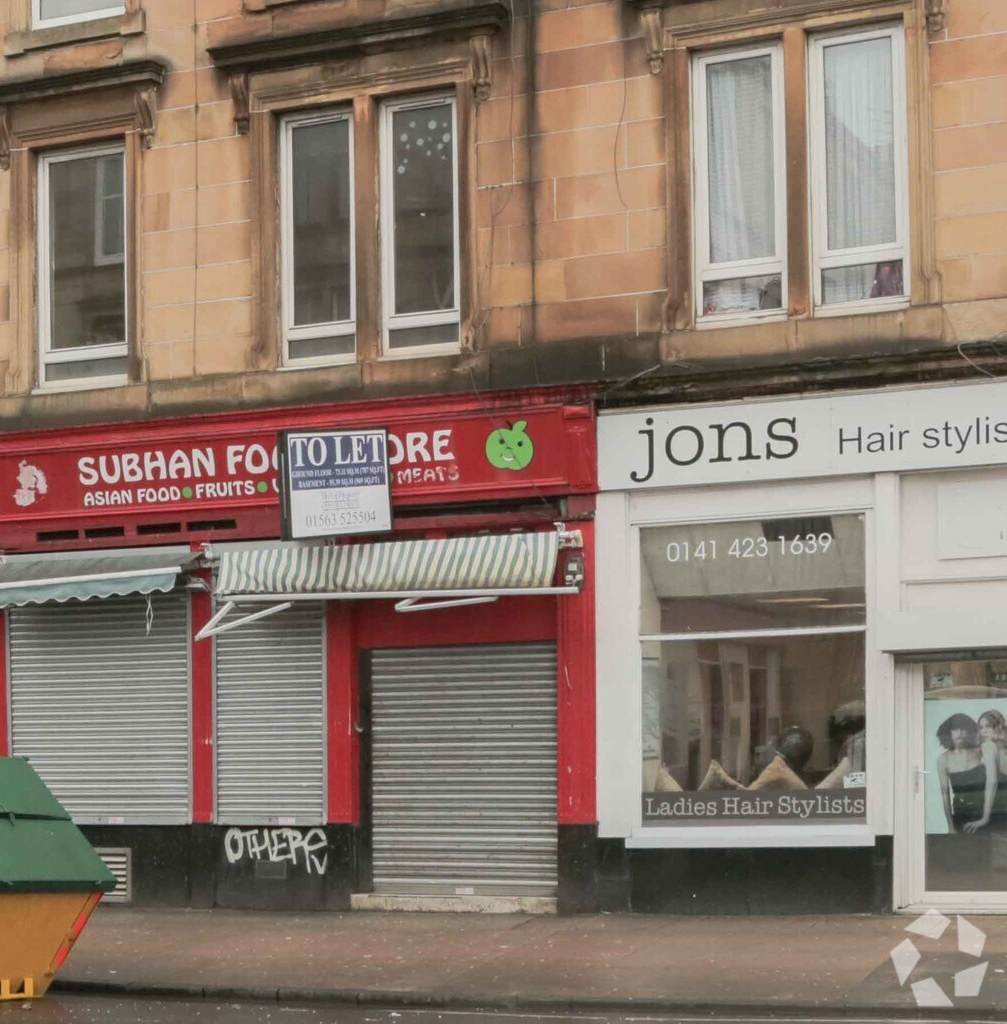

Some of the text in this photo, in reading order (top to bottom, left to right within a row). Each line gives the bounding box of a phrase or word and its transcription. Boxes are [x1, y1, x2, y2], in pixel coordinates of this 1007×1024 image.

[77, 429, 455, 486] SUBHAN FO ORE
[290, 434, 384, 467] TO LET
[630, 416, 1007, 483] jons Hair stylis
[84, 489, 133, 507] ASIAN
[136, 485, 182, 504] FOOD
[195, 479, 256, 499] FRUITS
[397, 463, 460, 485] MEATS
[305, 510, 376, 527] 01563 525504
[666, 532, 833, 562] 0141 423 1639
[645, 795, 865, 819] Ladies Hair Stylists
